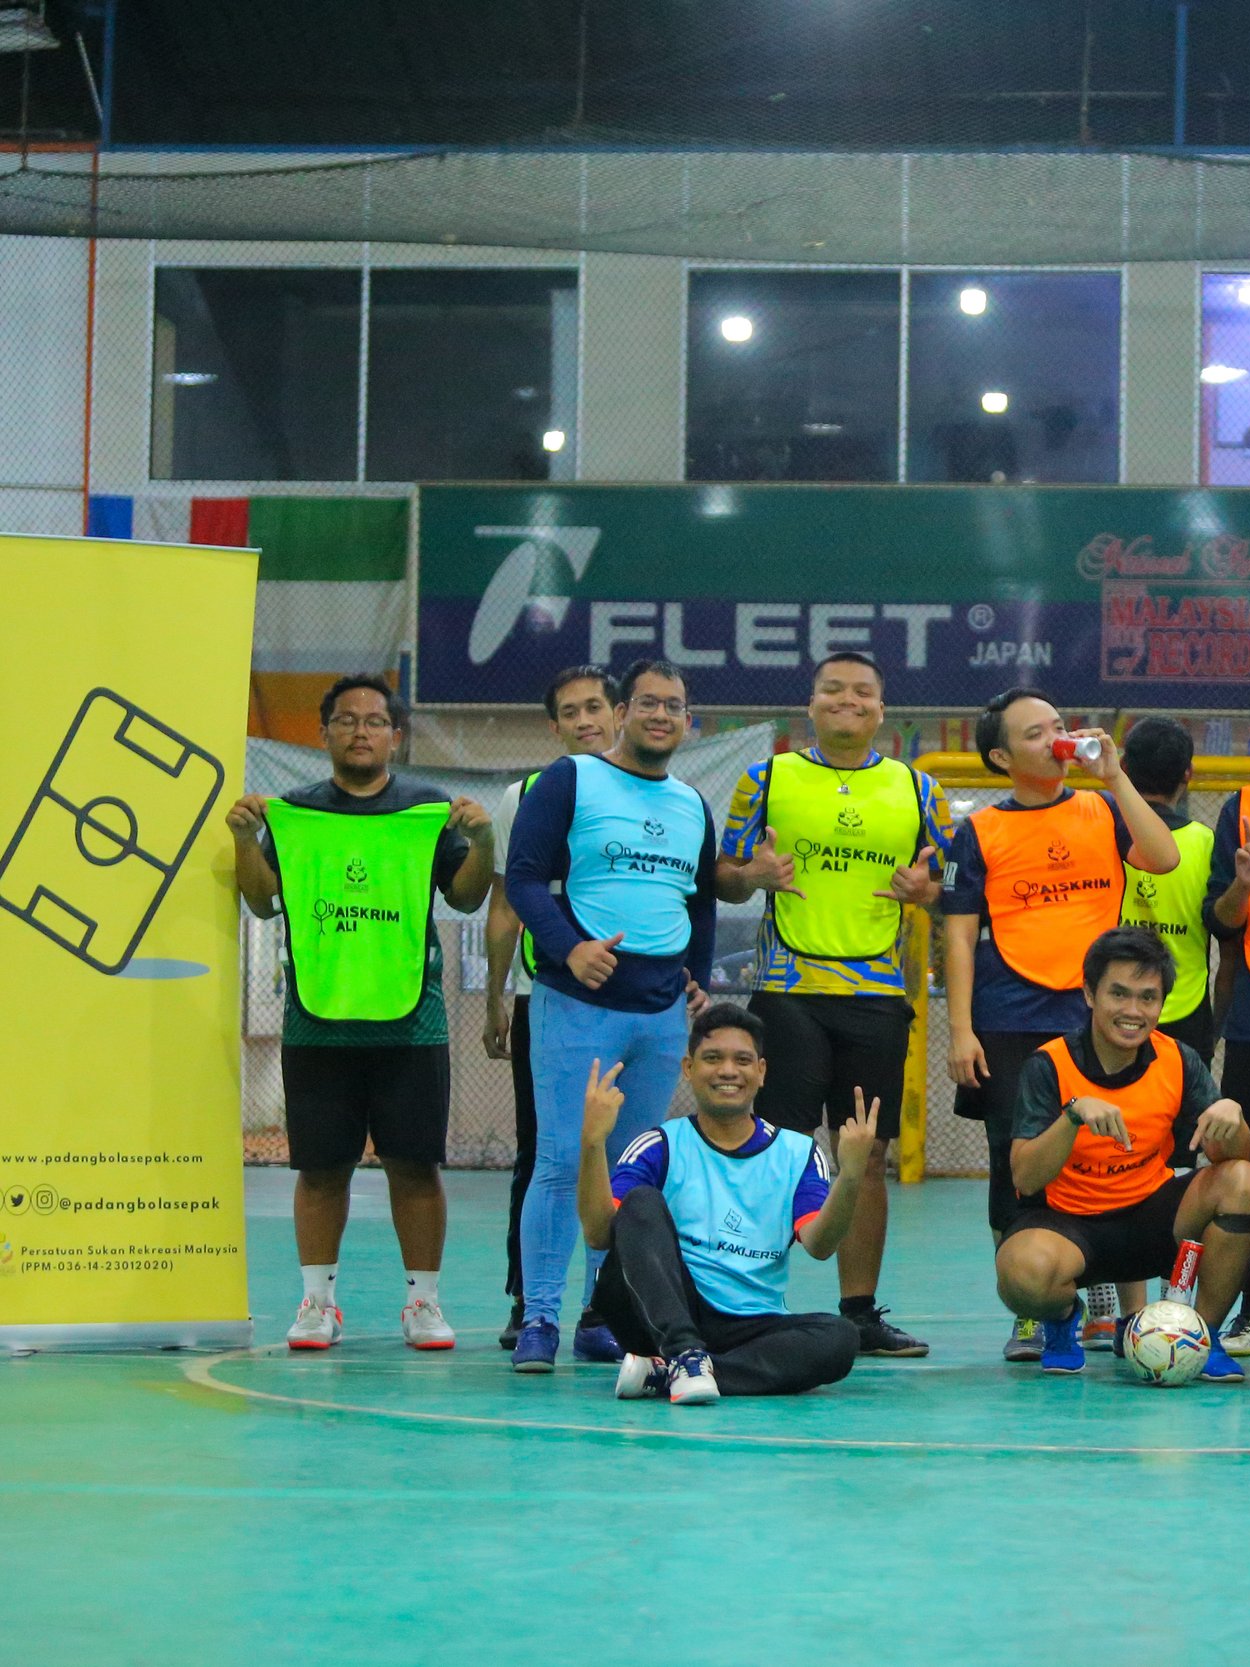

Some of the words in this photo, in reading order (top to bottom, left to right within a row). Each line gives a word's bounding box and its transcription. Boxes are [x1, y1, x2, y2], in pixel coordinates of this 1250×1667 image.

[589, 602, 952, 668] FLEET
[968, 641, 1053, 668] JAPAN
[821, 846, 896, 868] AISKRIM
[628, 861, 655, 874] ALI
[820, 860, 848, 872] ALI
[1040, 878, 1111, 895] AISKRIM
[335, 906, 400, 922] AISKRIM
[336, 920, 357, 932] ALI
[2, 1152, 203, 1166] www.padangbolasepak.com
[59, 1197, 220, 1213] @padangbolasepak
[21, 1246, 83, 1256] Persatuan
[87, 1245, 125, 1255] Sukan
[129, 1245, 182, 1255] Rekreasi
[184, 1244, 238, 1256] Malaysia
[21, 1260, 174, 1273] (PPM-036-14-23012020)
[1178, 1249, 1194, 1287] SaltCola
